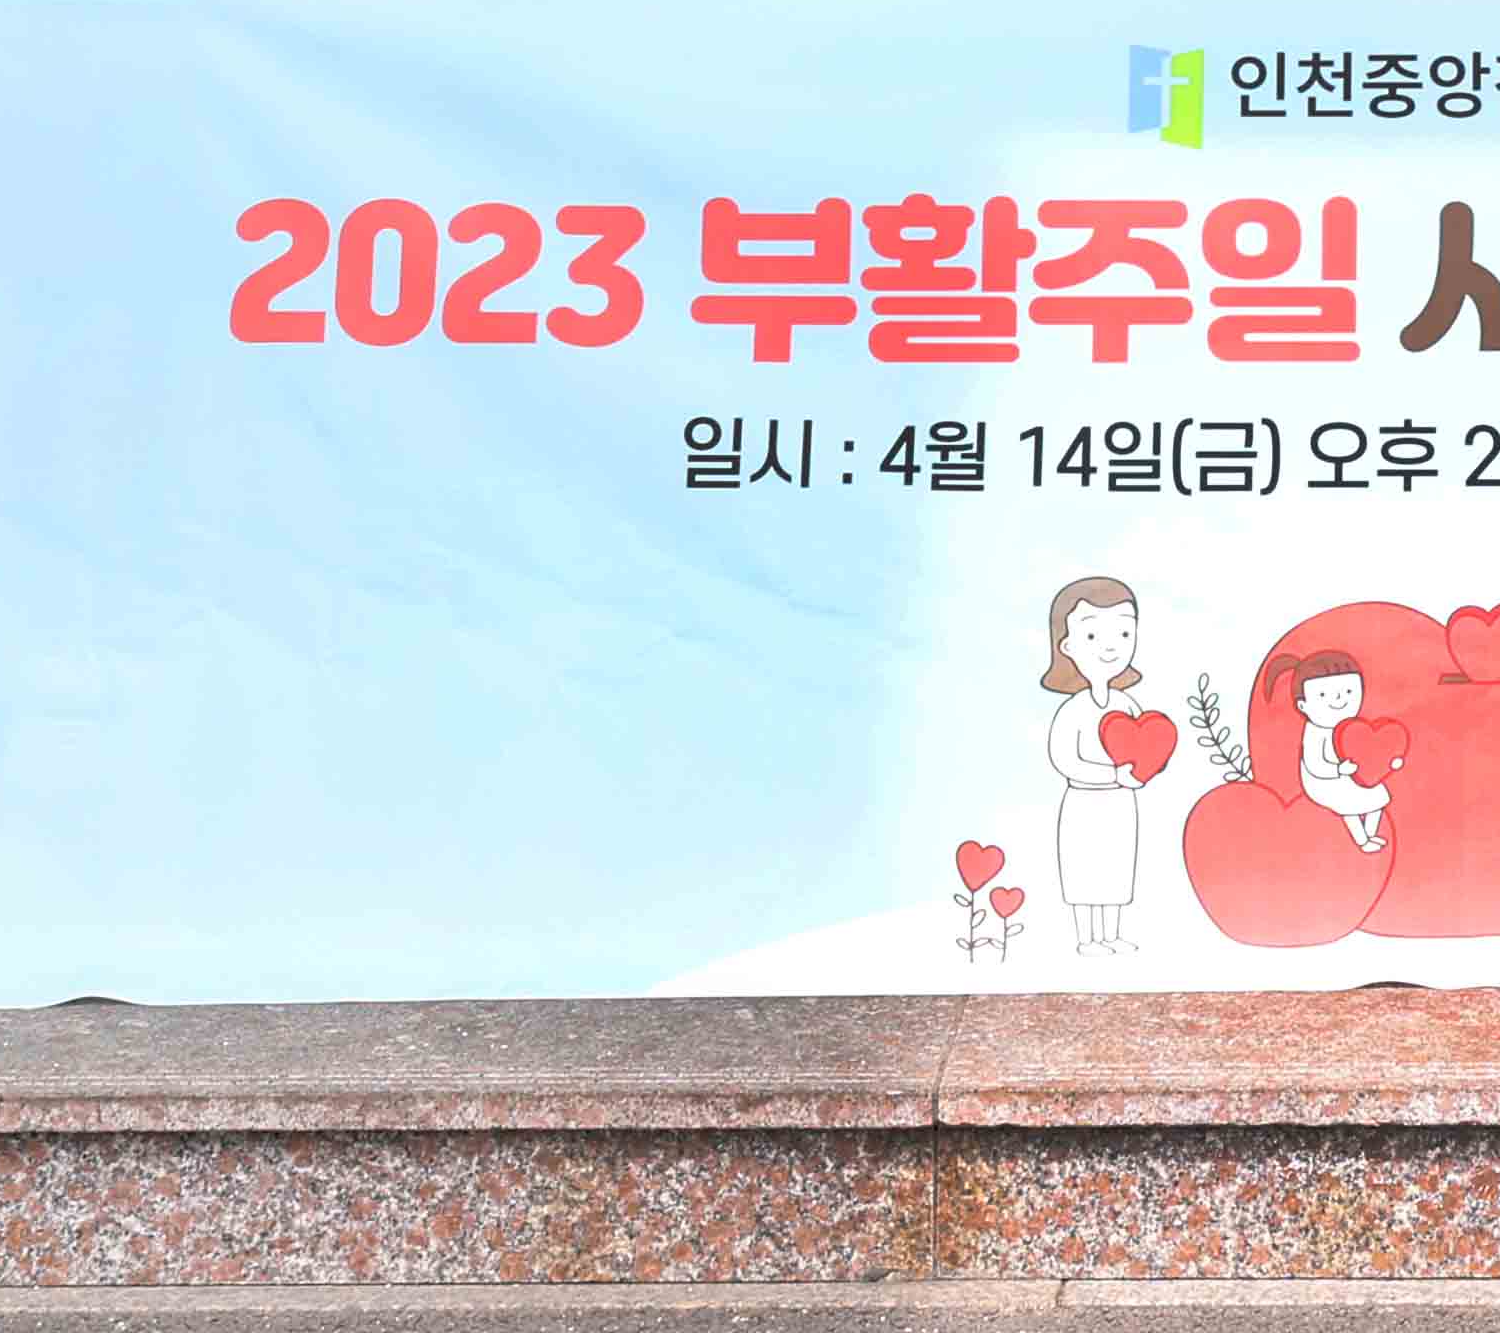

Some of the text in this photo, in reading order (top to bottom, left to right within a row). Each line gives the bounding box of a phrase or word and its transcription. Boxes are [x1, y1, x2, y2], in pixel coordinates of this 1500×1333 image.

[230, 198, 645, 347] 2023
[690, 193, 1360, 363] 부활주일
[684, 417, 812, 490] 일시
[879, 421, 986, 491] 4월
[1020, 418, 1280, 496] 14일(금)
[1308, 419, 1438, 492] 오후
